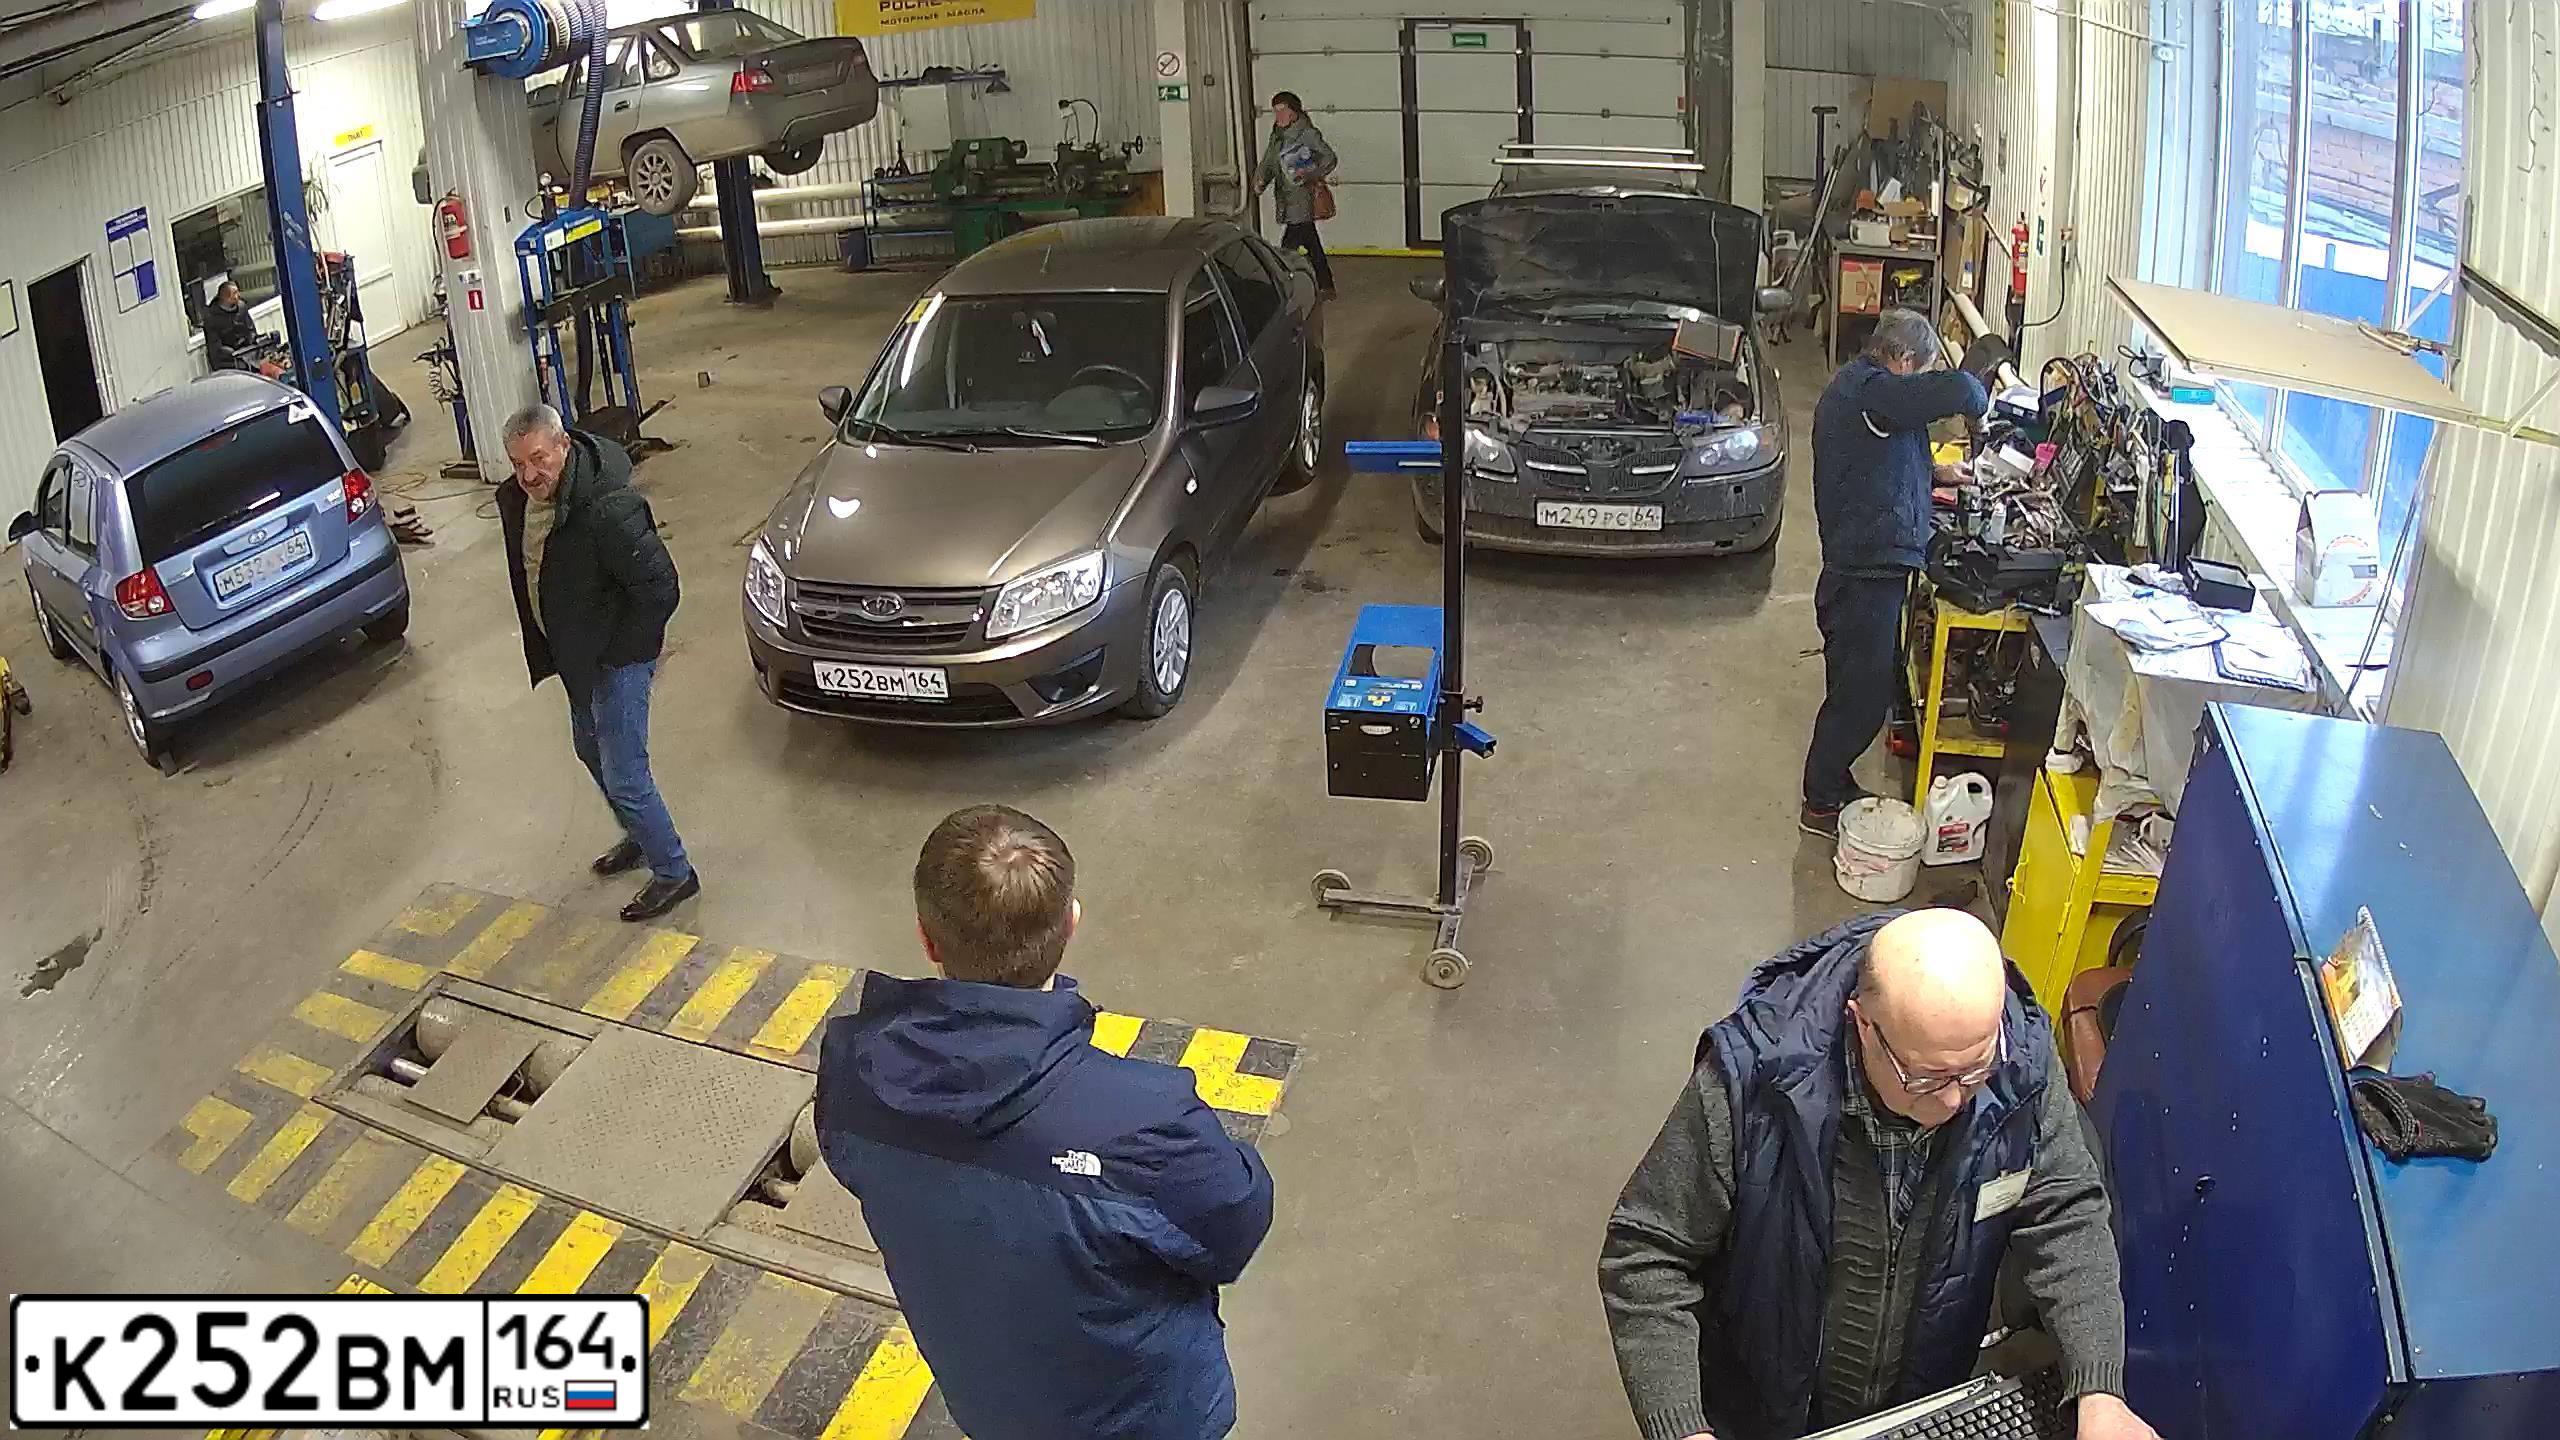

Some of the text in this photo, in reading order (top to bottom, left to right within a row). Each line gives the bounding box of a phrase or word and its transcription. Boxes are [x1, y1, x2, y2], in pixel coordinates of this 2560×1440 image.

[880, 7, 986, 26] МОТОРНЫЕ МАСЛА
[1635, 508, 1655, 523] 64
[222, 556, 286, 591] М532
[821, 667, 941, 693] К252ВМ 164
